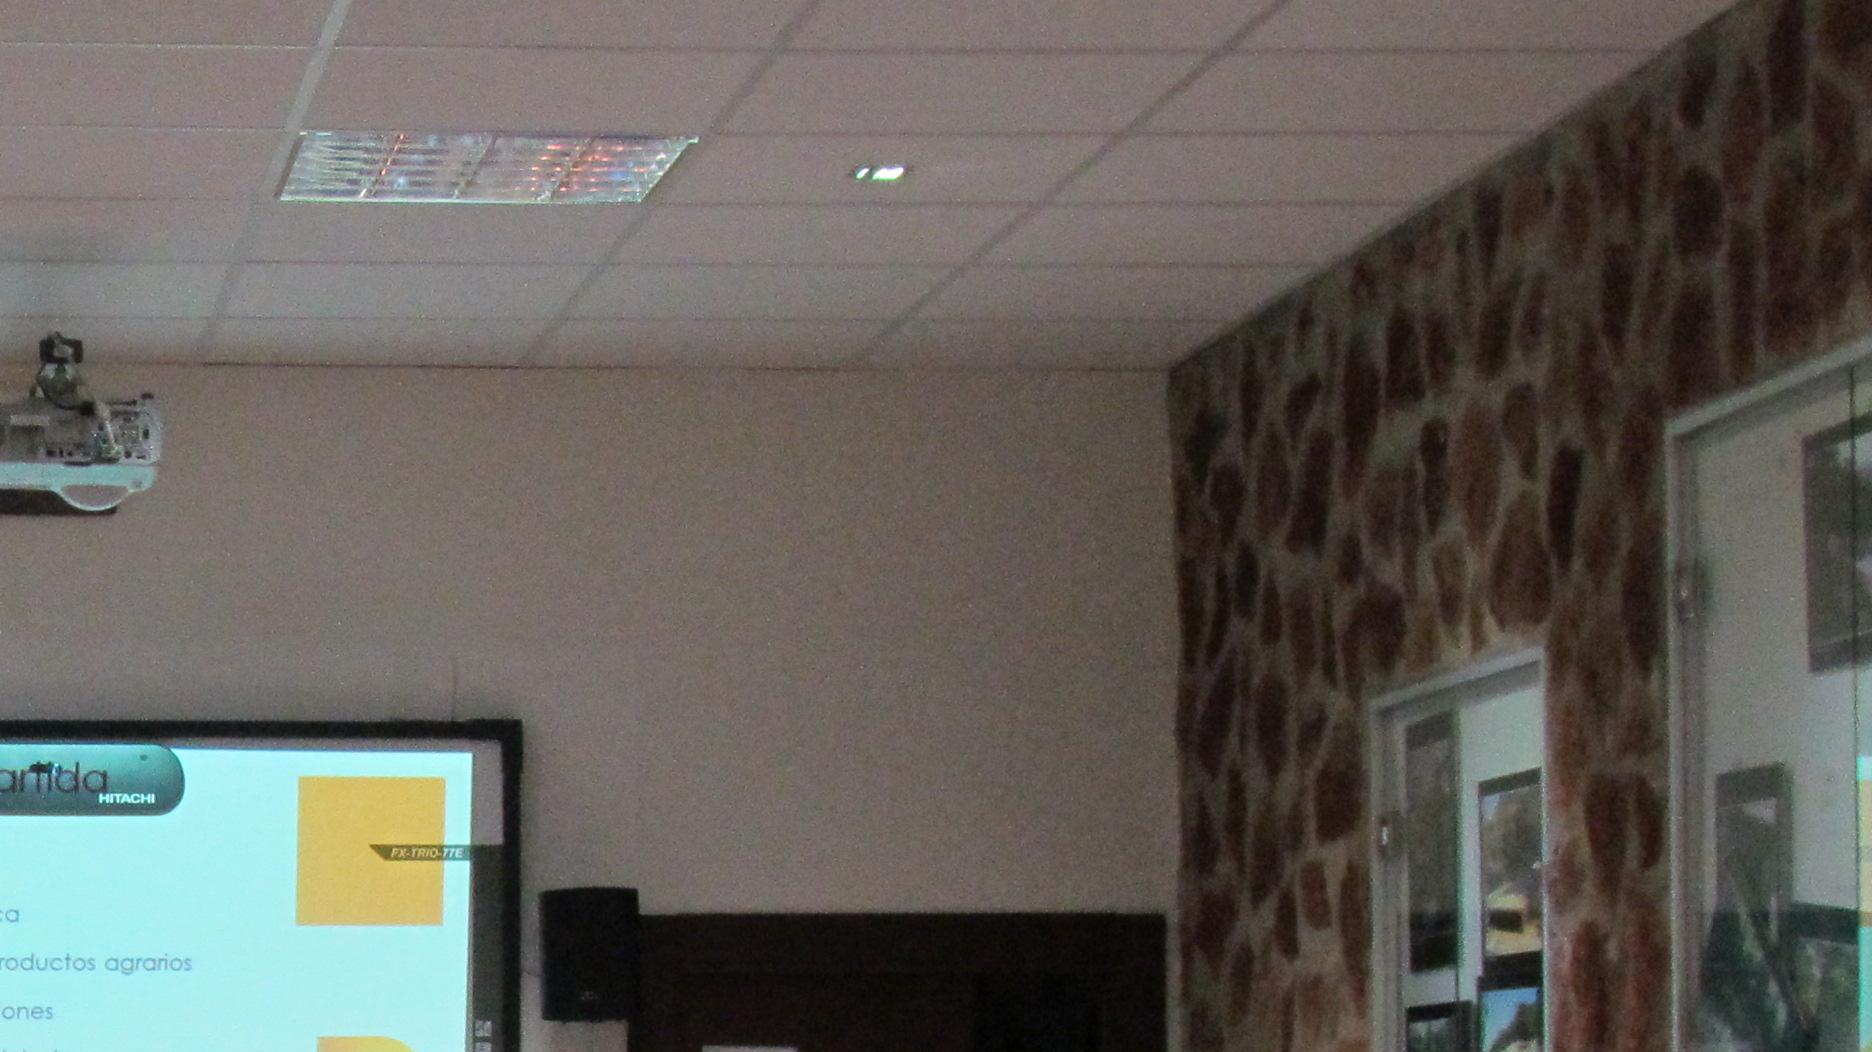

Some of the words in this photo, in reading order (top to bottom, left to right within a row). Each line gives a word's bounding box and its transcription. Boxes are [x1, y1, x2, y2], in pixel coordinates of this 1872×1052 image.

[98, 792, 156, 804] HITACHI
[390, 847, 465, 859] FX-TRIO-77E
[104, 953, 193, 976] agrarios
